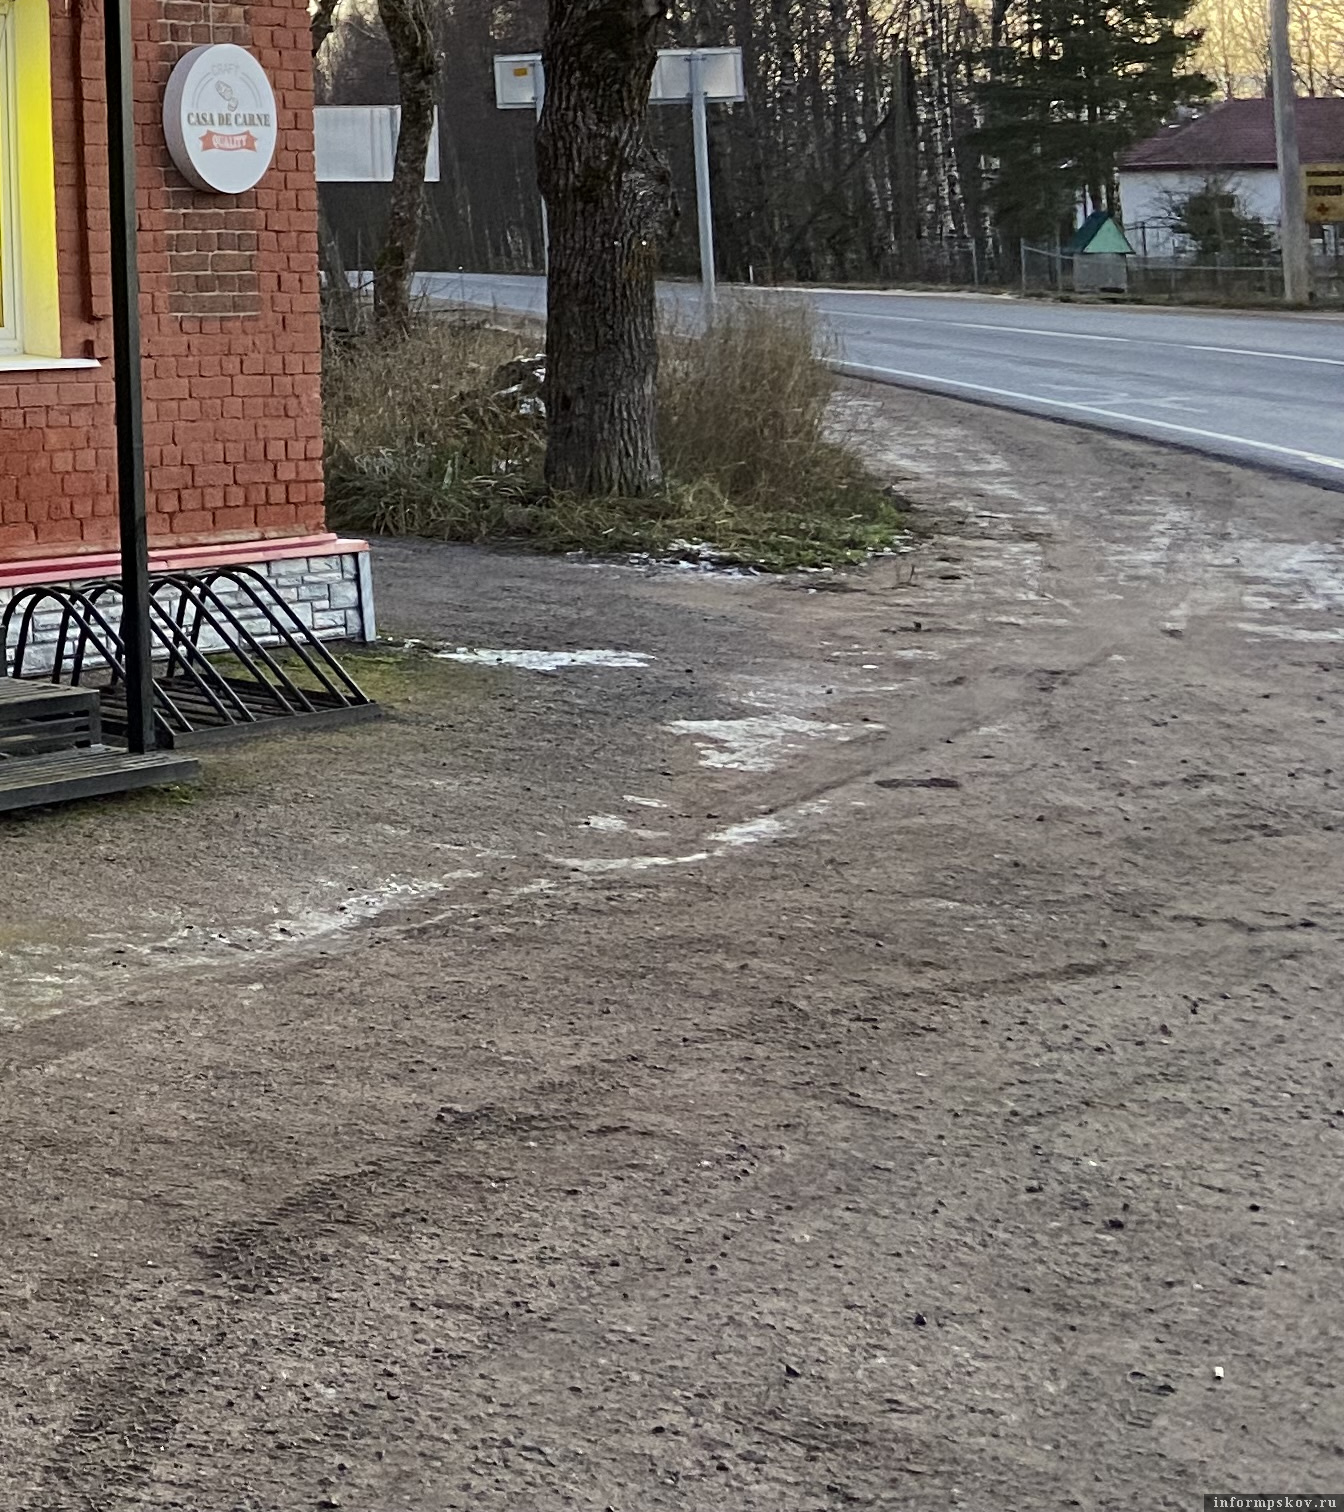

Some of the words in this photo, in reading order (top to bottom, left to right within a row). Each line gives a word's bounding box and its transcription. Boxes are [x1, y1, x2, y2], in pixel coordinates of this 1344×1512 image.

[212, 63, 241, 76] CRAFT
[187, 111, 215, 127] CASA
[218, 112, 233, 127] DE
[234, 112, 271, 128] CARNE
[212, 134, 247, 149] QUALITY
